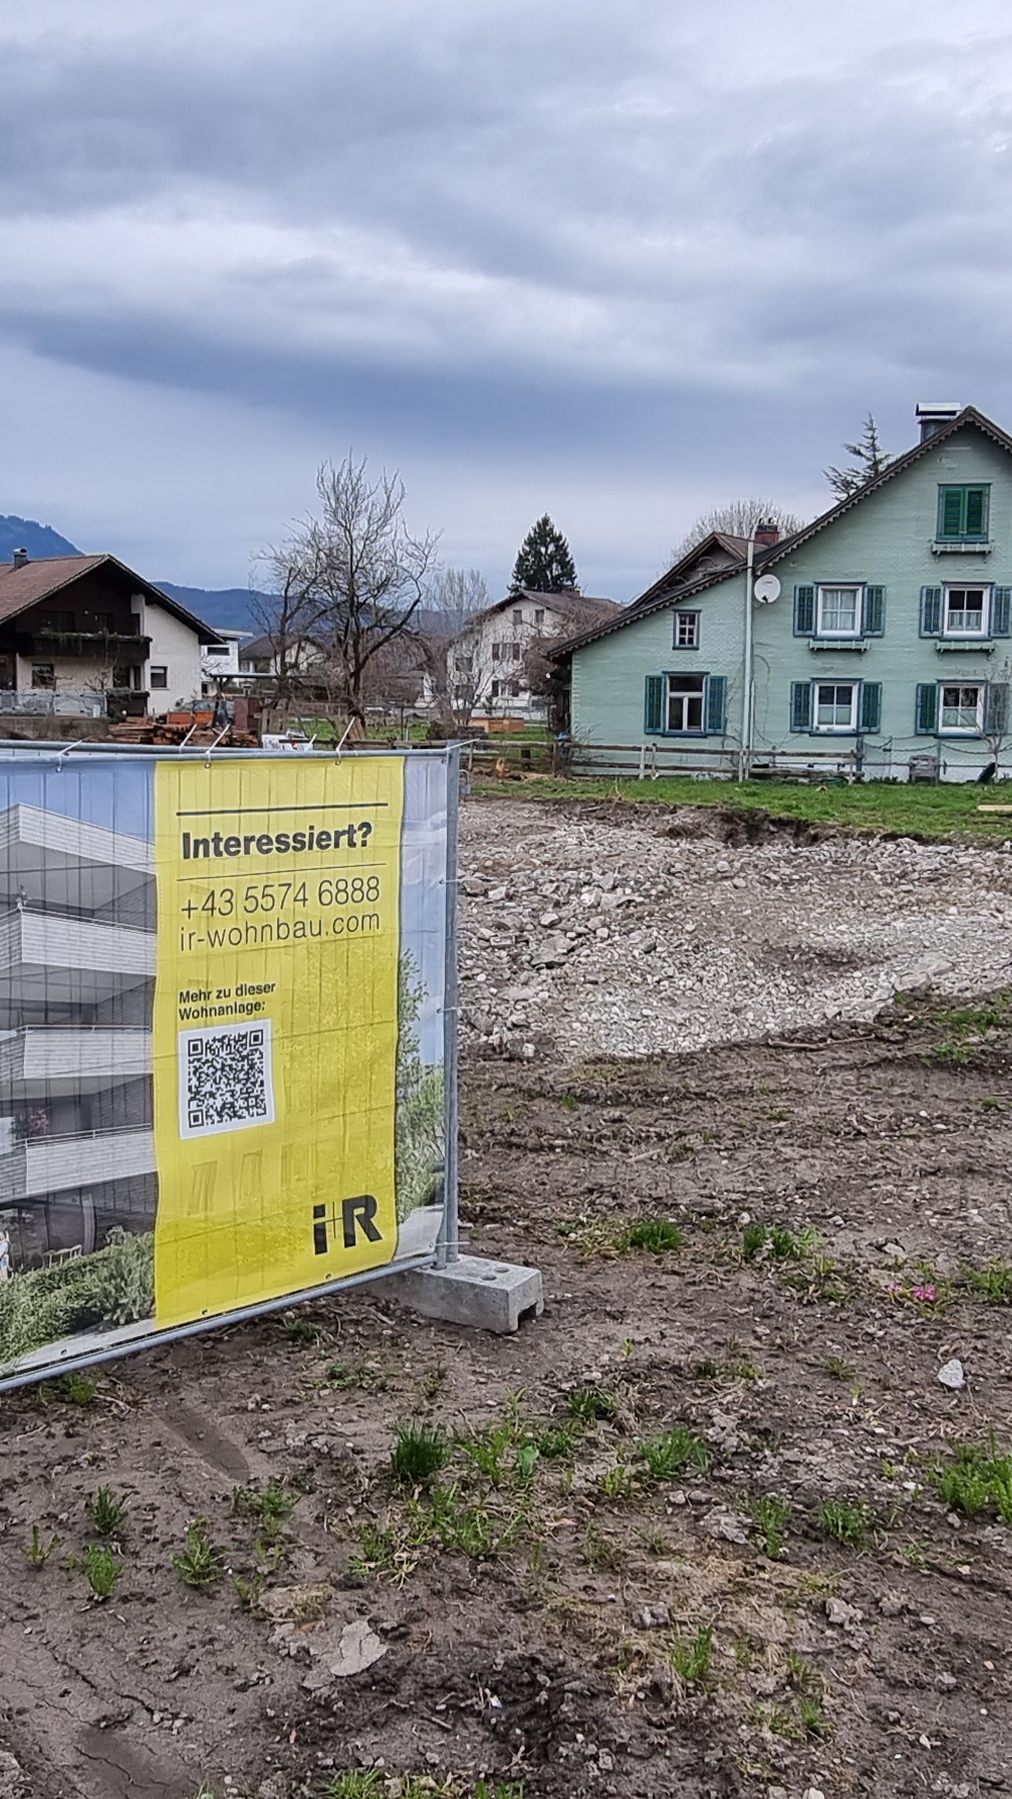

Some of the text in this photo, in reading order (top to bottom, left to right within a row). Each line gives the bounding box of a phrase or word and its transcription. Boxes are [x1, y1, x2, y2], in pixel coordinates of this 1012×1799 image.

[182, 822, 373, 860] Interessiert?
[181, 876, 380, 919] +43 5574 6888
[179, 912, 380, 951] ir-wohnbau.com
[179, 983, 276, 1004] Mehr zu dieser
[179, 1001, 266, 1021] Wohnanlage:
